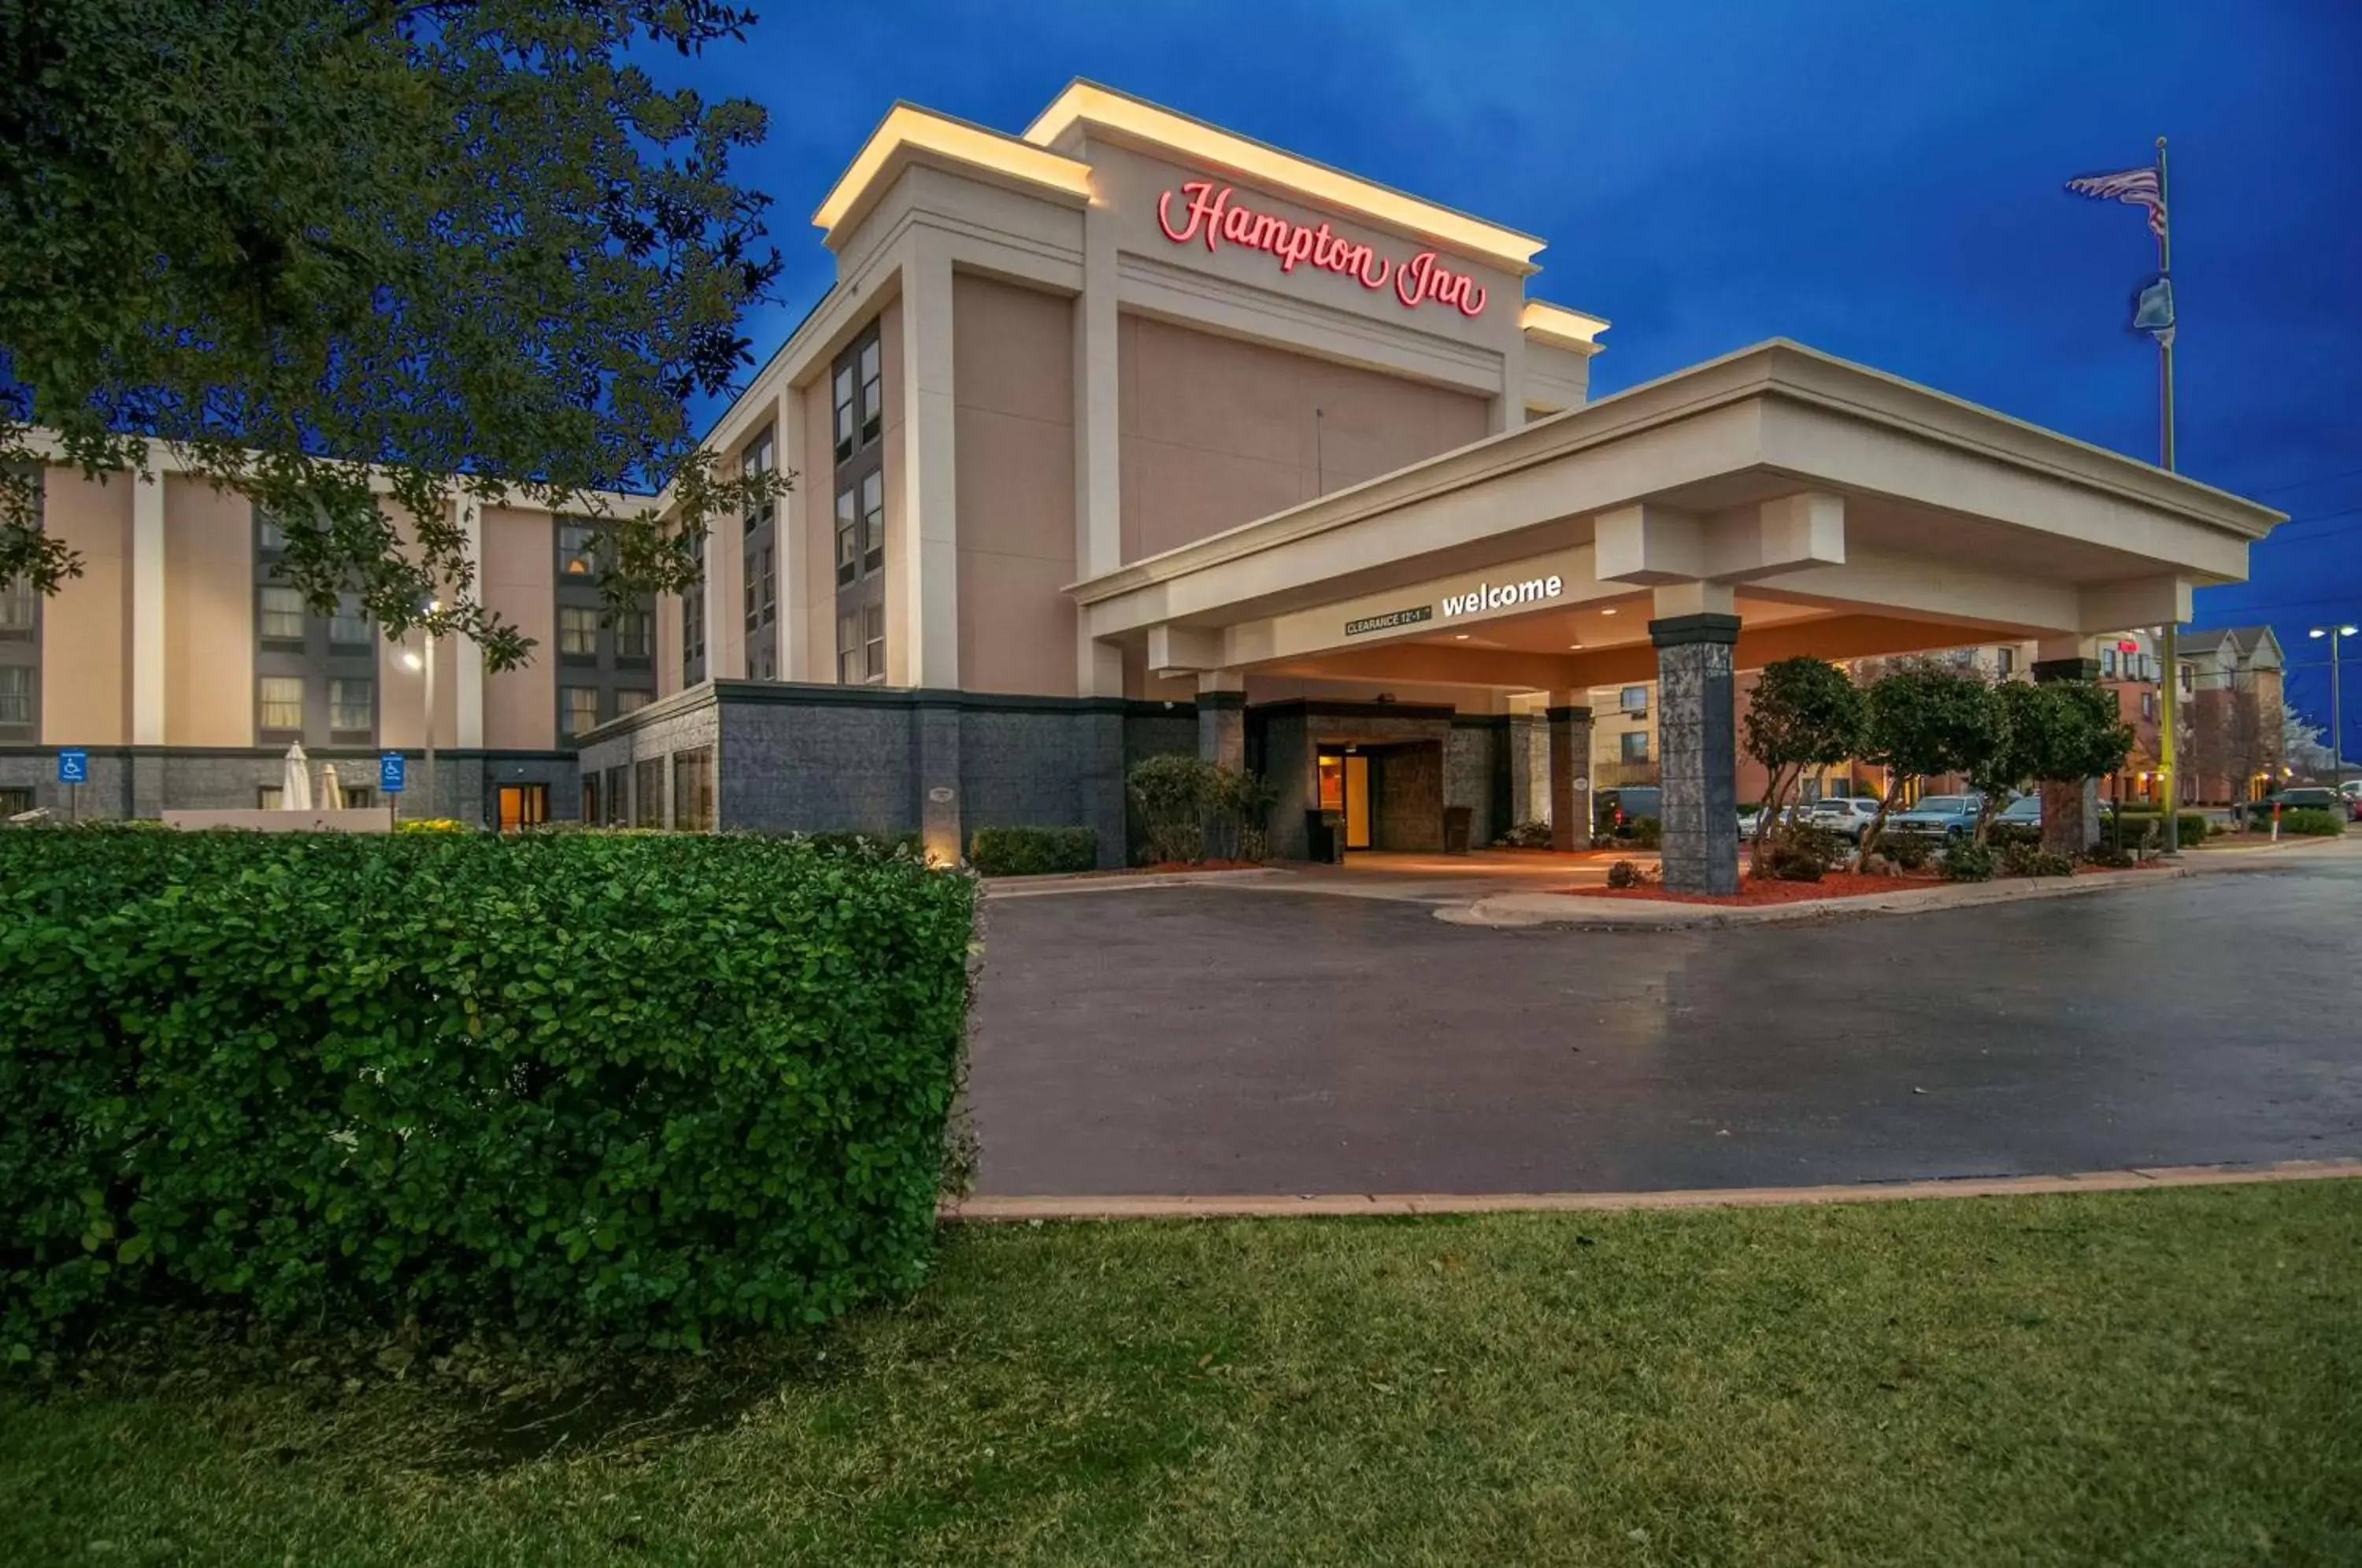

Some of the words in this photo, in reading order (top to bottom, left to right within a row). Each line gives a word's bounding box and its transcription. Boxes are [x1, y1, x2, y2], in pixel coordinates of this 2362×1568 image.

[1158, 182, 1390, 289] Hampton
[1394, 251, 1486, 317] Inn
[1442, 575, 1563, 617] welcome
[1347, 614, 1399, 634] CLEARANCE
